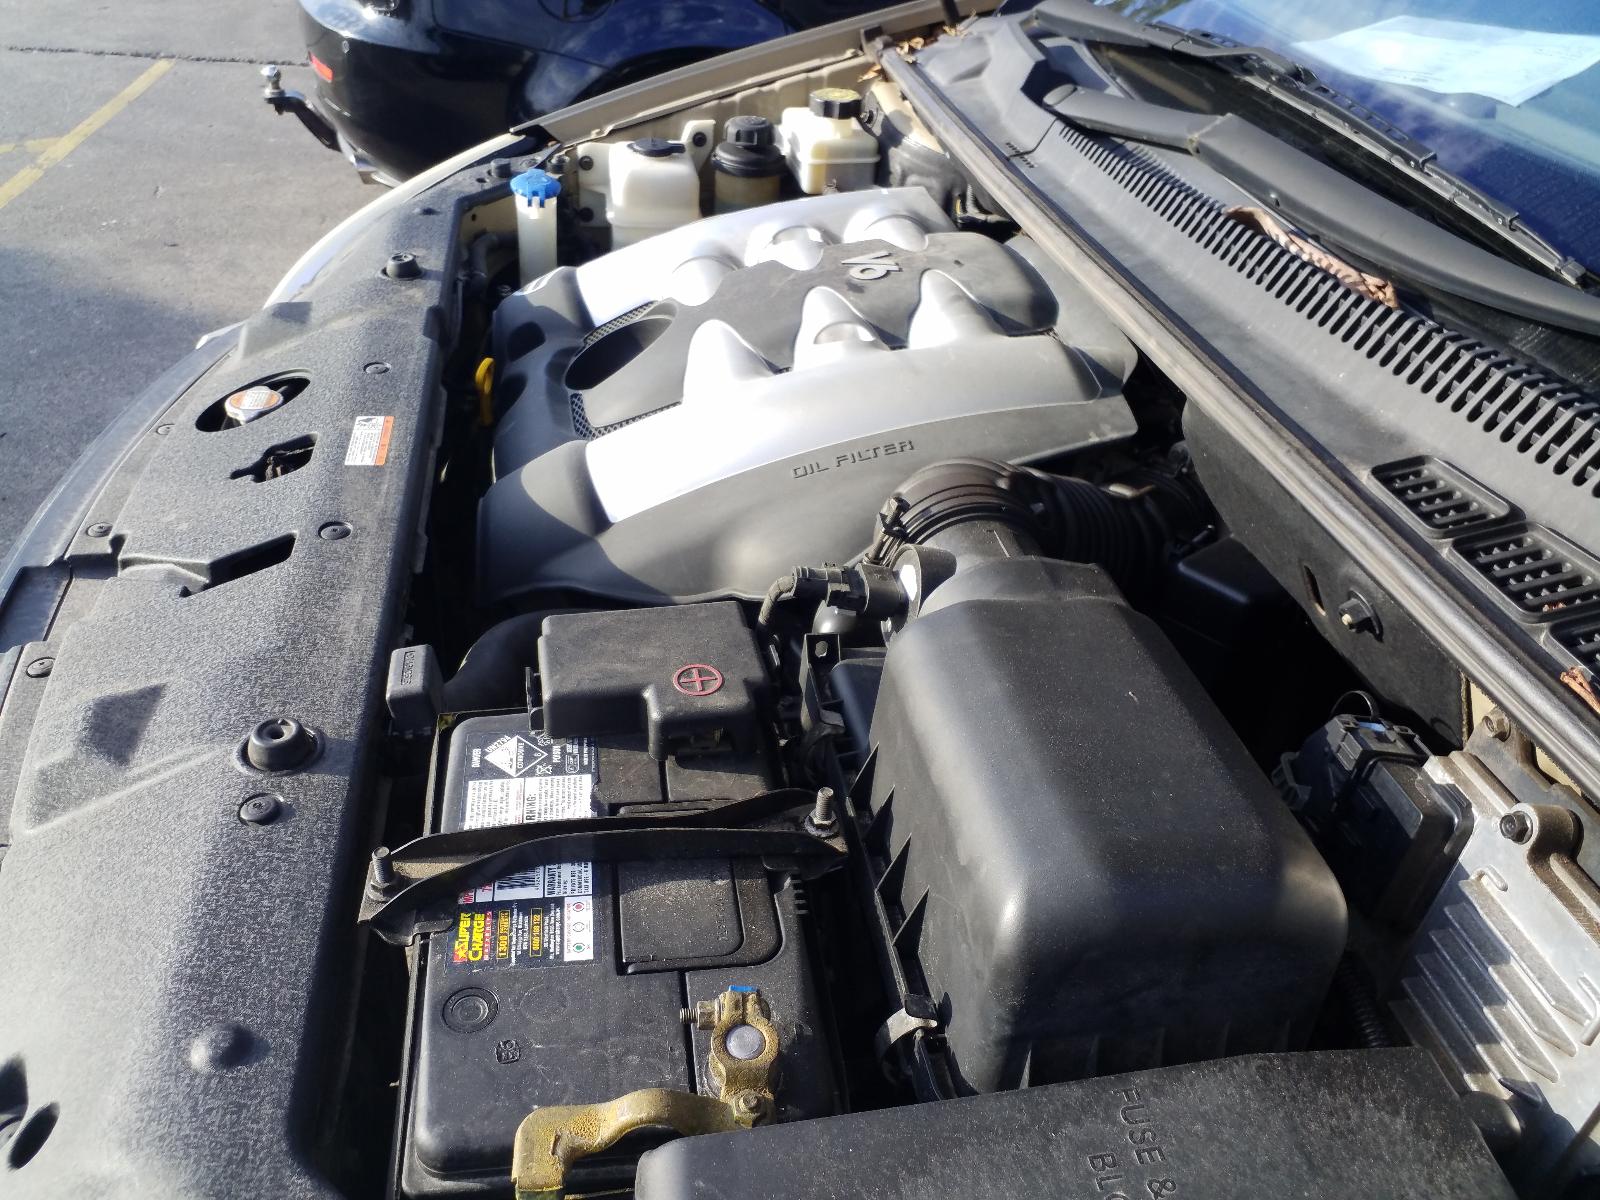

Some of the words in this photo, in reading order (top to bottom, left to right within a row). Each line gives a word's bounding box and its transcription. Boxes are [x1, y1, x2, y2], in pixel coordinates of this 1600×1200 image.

[841, 251, 903, 280] V6
[792, 462, 831, 479] OIL
[835, 440, 915, 468] FILTER
[525, 793, 537, 821] RNING:
[454, 912, 471, 951] SUPER
[467, 913, 485, 961] CHARGE
[498, 936, 508, 958] 1300
[1111, 1088, 1167, 1165] FUSE
[1146, 1178, 1177, 1200] &
